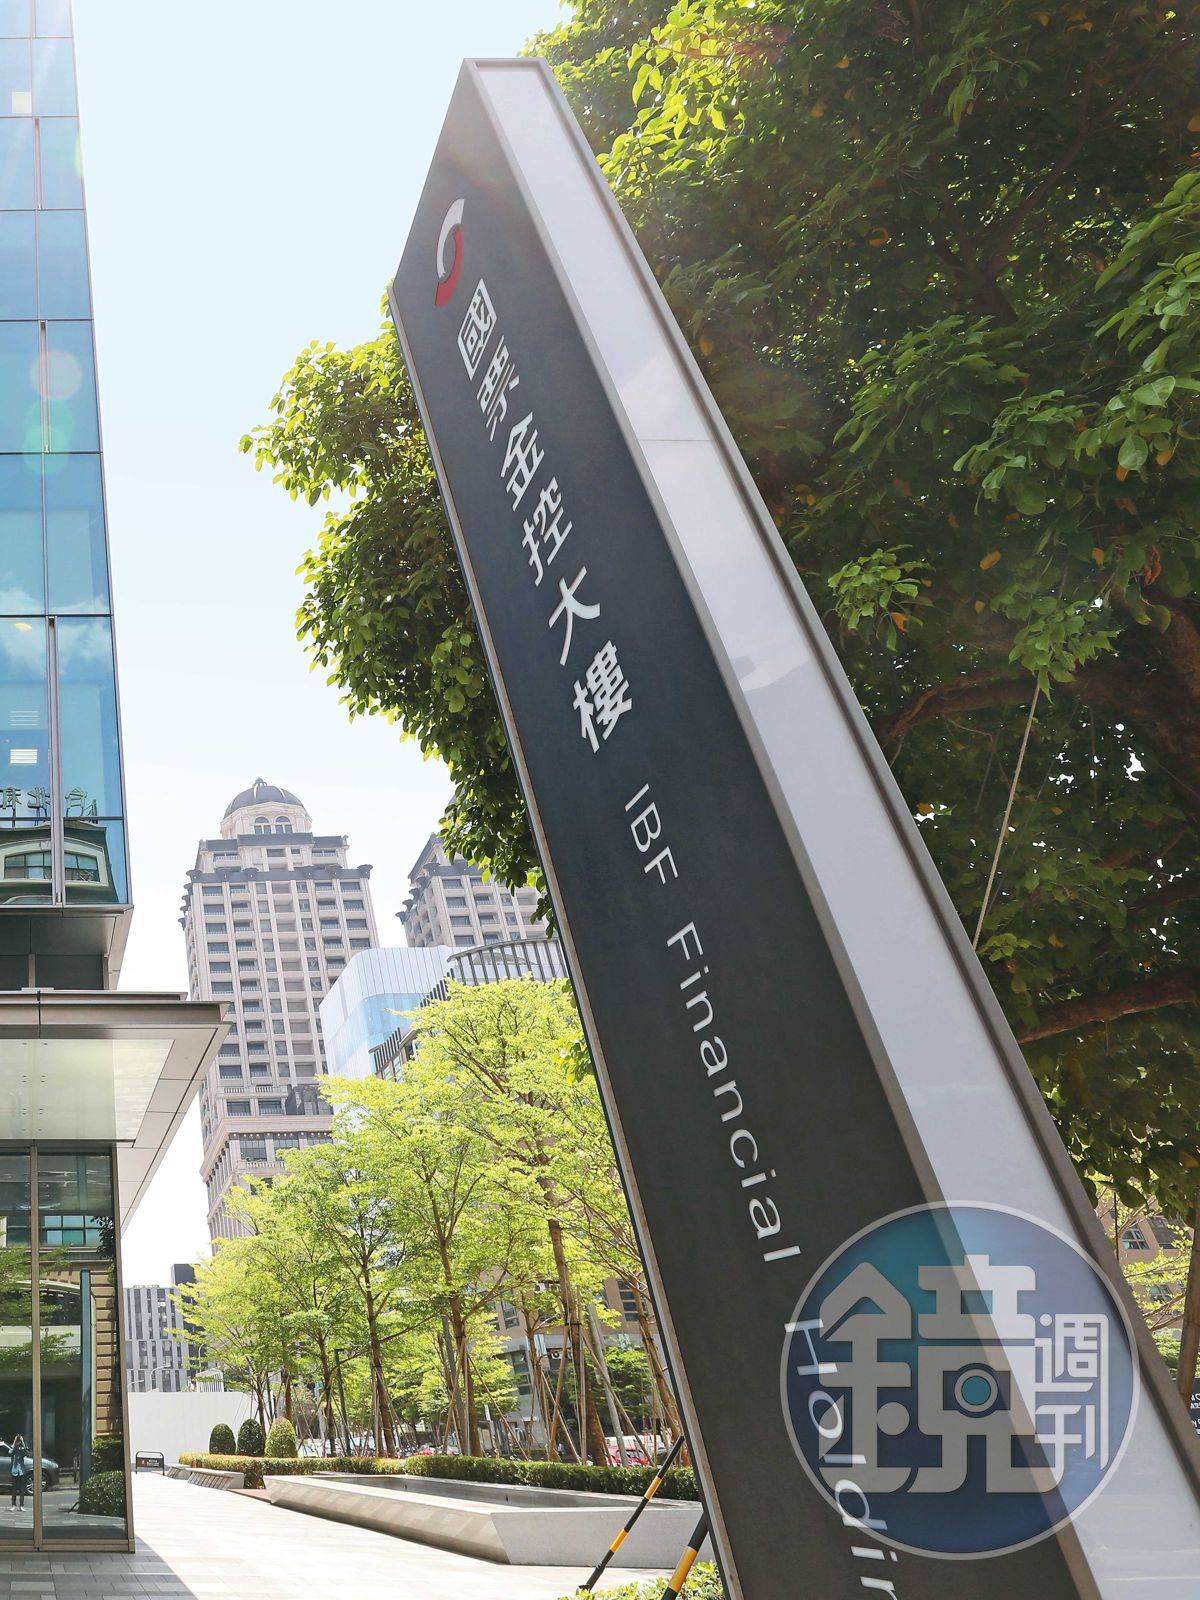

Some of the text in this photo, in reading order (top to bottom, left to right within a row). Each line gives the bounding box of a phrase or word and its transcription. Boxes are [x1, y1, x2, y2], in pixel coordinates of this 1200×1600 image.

[457, 278, 632, 754] 國票金控大樓
[624, 784, 679, 885] IBF
[666, 921, 801, 1263] Financial
